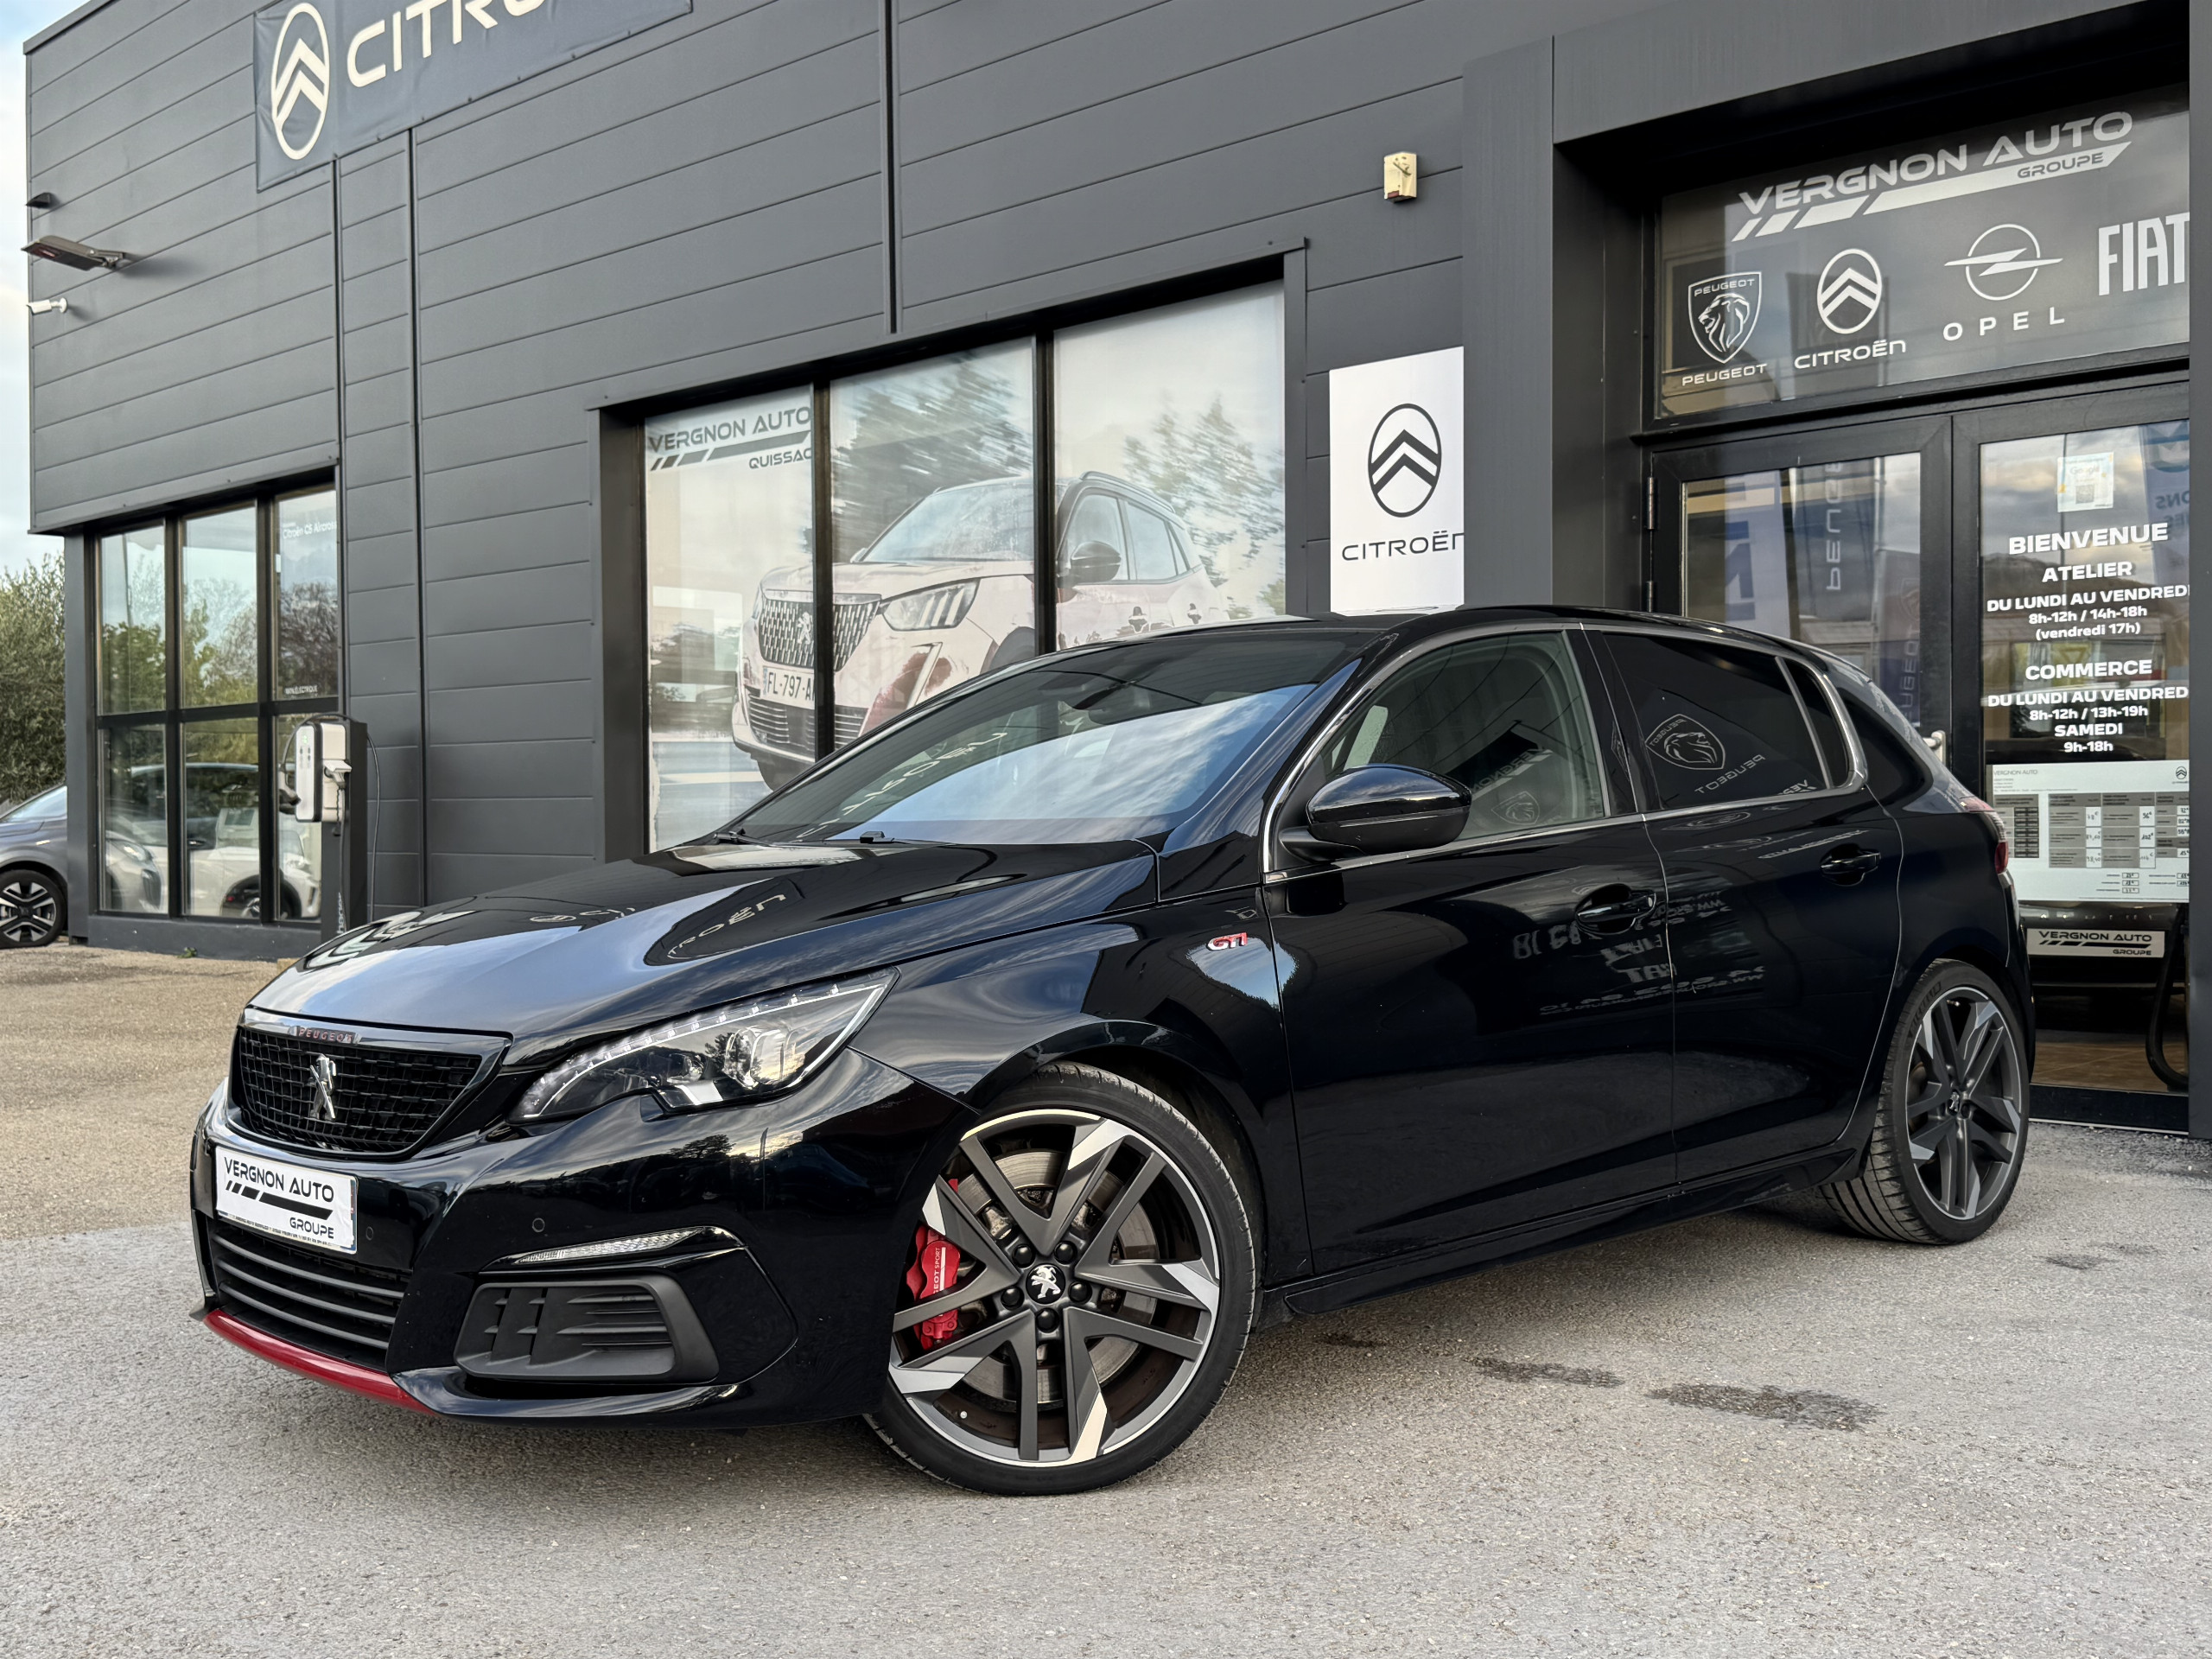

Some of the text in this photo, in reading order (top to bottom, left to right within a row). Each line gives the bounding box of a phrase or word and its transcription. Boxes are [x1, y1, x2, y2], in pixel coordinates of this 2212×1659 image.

[347, 0, 548, 87] CITR
[1738, 111, 2133, 215] VERGNON AUTO
[2018, 152, 2104, 179] GROUPE
[2099, 212, 2190, 296] FIAT
[1694, 278, 1756, 296] PEUGEOT
[1943, 307, 2065, 340] OPEL
[1682, 363, 1768, 386] PEUGEOT
[649, 406, 811, 453] VERGNON AUTO
[748, 448, 811, 469] QUISSAC
[2009, 523, 2169, 555] BIENVENUE
[2042, 562, 2132, 582] ATELIER
[1987, 599, 2012, 612] DU
[2015, 594, 2067, 609] LUNDI
[2070, 592, 2096, 605] AU
[2029, 611, 2077, 625] 8h-12h
[2089, 606, 2147, 620] 14h-18h
[2036, 622, 2141, 640] (vendredi 17h)
[2025, 659, 2152, 681] COMMERCE
[1988, 695, 2012, 707] DU
[2016, 691, 2067, 705] LUNDI
[2071, 690, 2096, 703] AU
[2030, 709, 2078, 721] 8h-12h
[2091, 706, 2148, 718] 13h-19h
[2055, 723, 2122, 737] SAMEDI
[2064, 741, 2113, 753] 9h-18h
[2039, 931, 2109, 940] VERGNON
[299, 1027, 353, 1043] PEUGEOT
[224, 1156, 334, 1203] VERGNON AUTO
[289, 1217, 334, 1239] GROUPE
